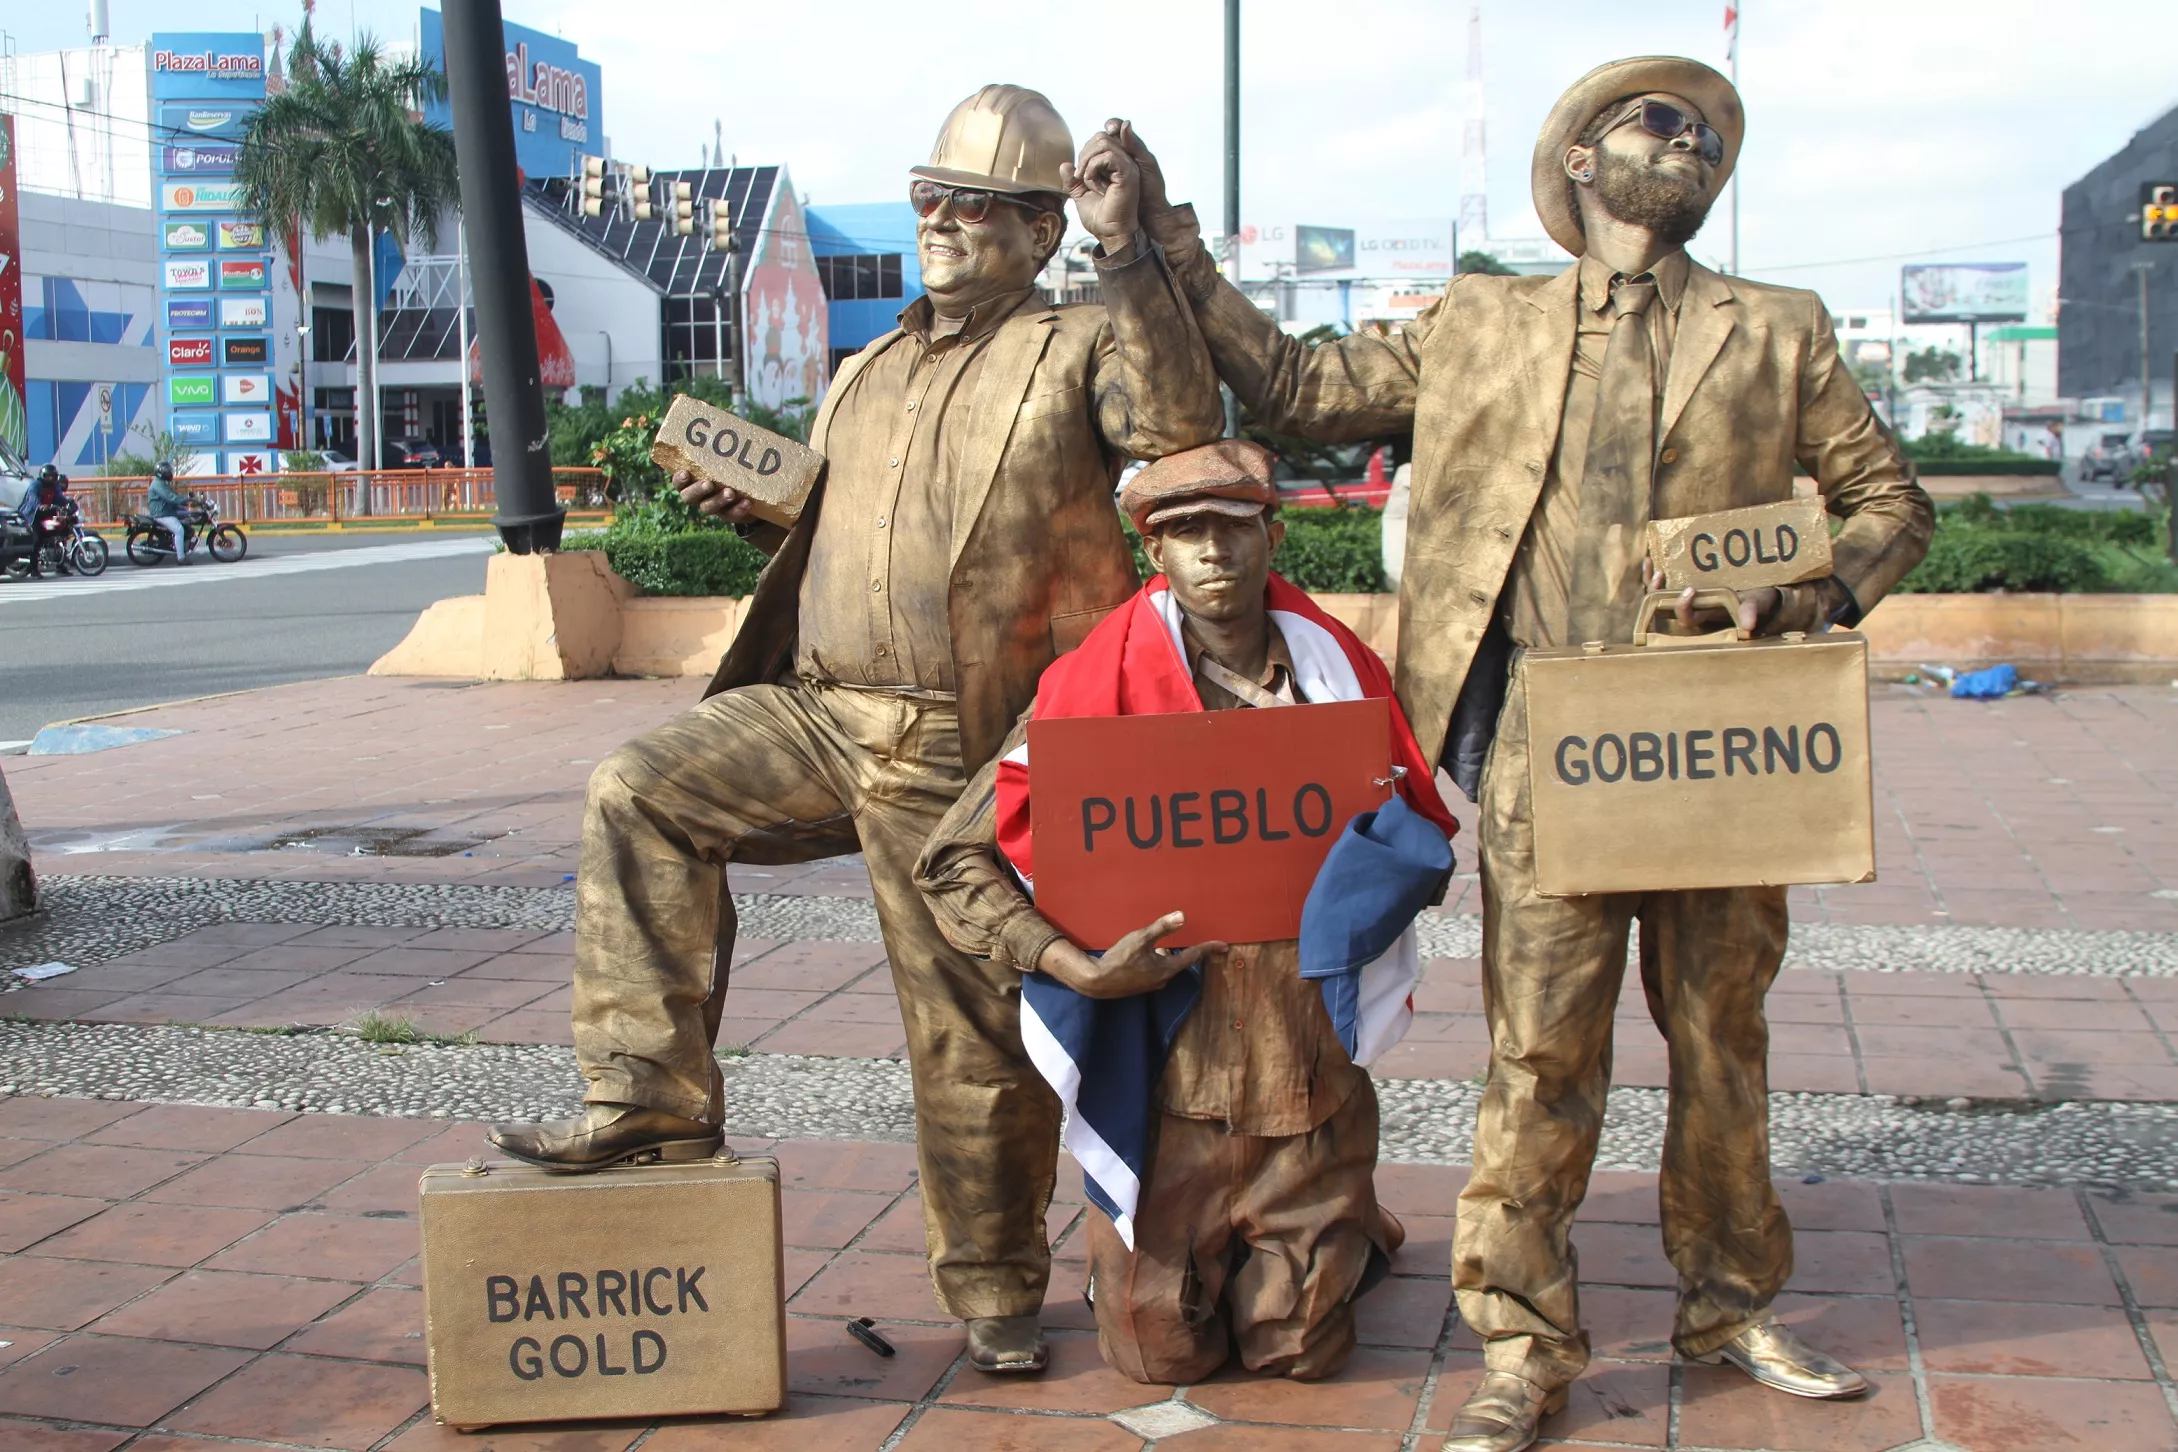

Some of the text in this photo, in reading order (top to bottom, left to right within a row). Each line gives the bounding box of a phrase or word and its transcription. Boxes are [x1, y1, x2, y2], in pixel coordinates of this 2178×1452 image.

[506, 42, 588, 119] aLama
[190, 111, 231, 119] BanReservas
[1261, 226, 1284, 242] LG
[1361, 239, 1379, 251] LG
[1422, 238, 1440, 250] TV
[245, 308, 263, 316] BON
[171, 346, 204, 358] Claro
[230, 346, 260, 354] Orange
[685, 417, 782, 476] GOLD
[1690, 523, 1799, 573] GOLD
[1554, 722, 1842, 786] GOBIERNO
[1080, 782, 1333, 852] PUEBLO
[485, 1265, 709, 1323] BARRICK
[508, 1329, 668, 1381] GOLD
